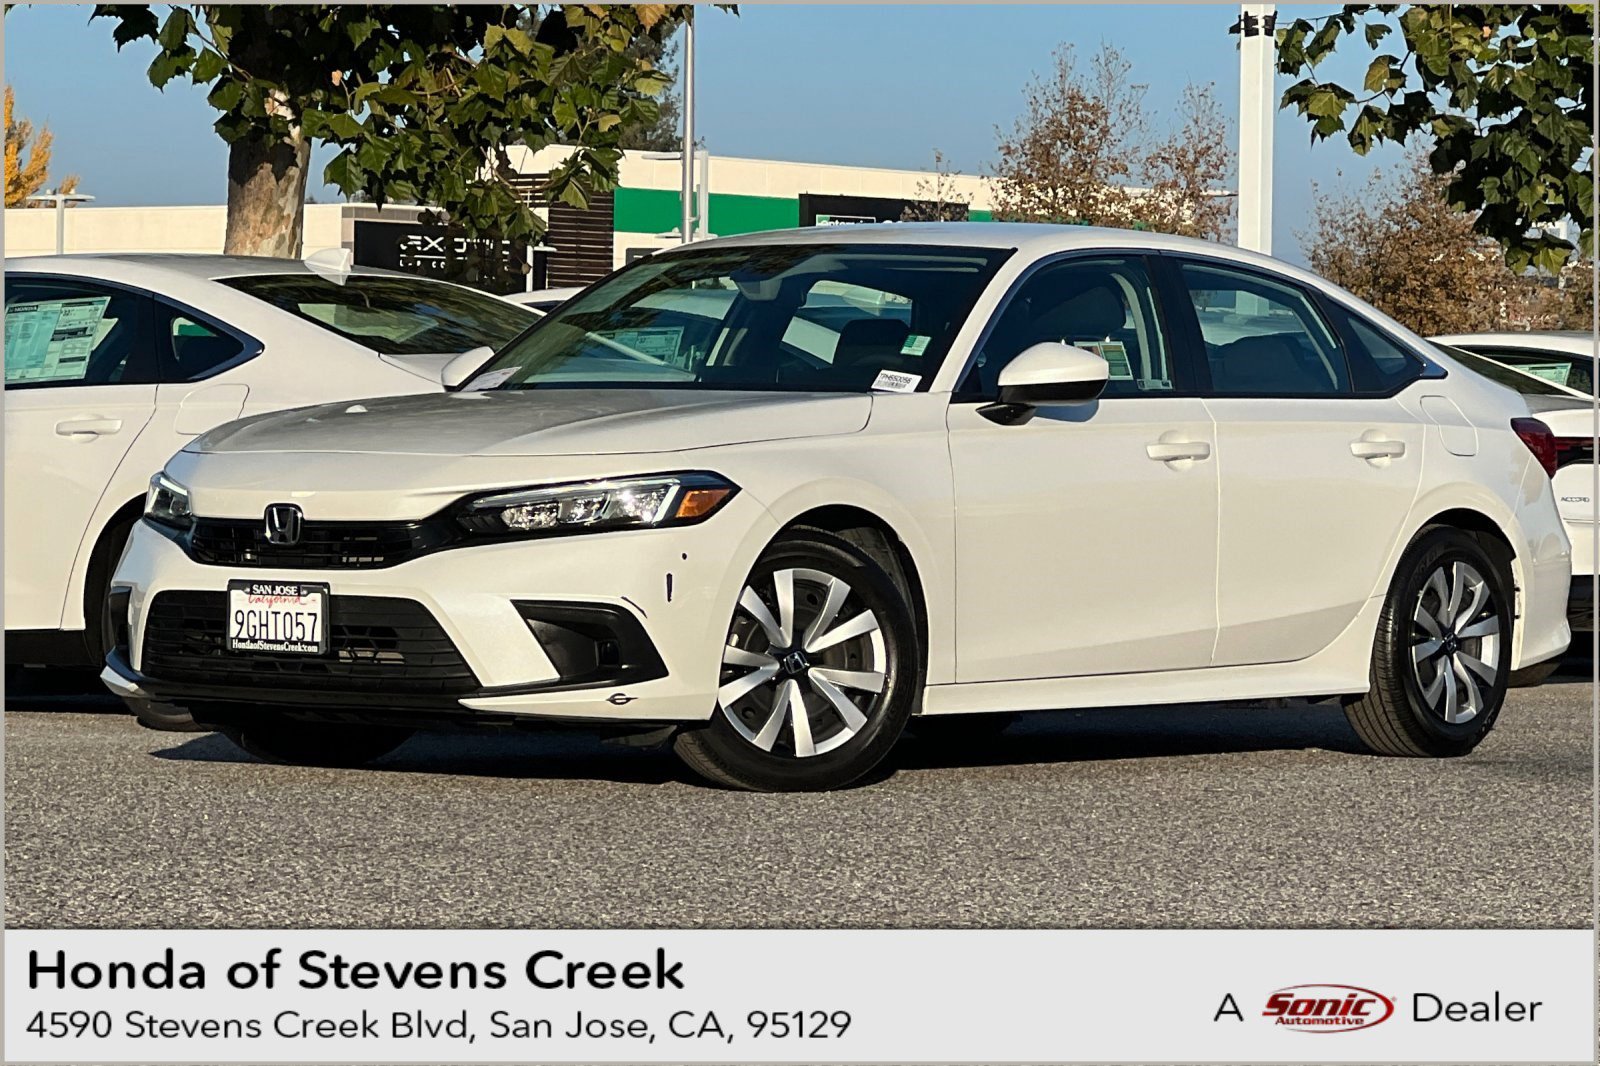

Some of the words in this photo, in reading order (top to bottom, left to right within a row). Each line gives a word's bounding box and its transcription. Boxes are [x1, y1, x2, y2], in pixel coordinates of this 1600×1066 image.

[252, 584, 272, 595] SAN
[273, 586, 299, 596] JOSE
[235, 610, 317, 642] 9GHT057
[232, 638, 318, 653] HondaofStevensCreek.com
